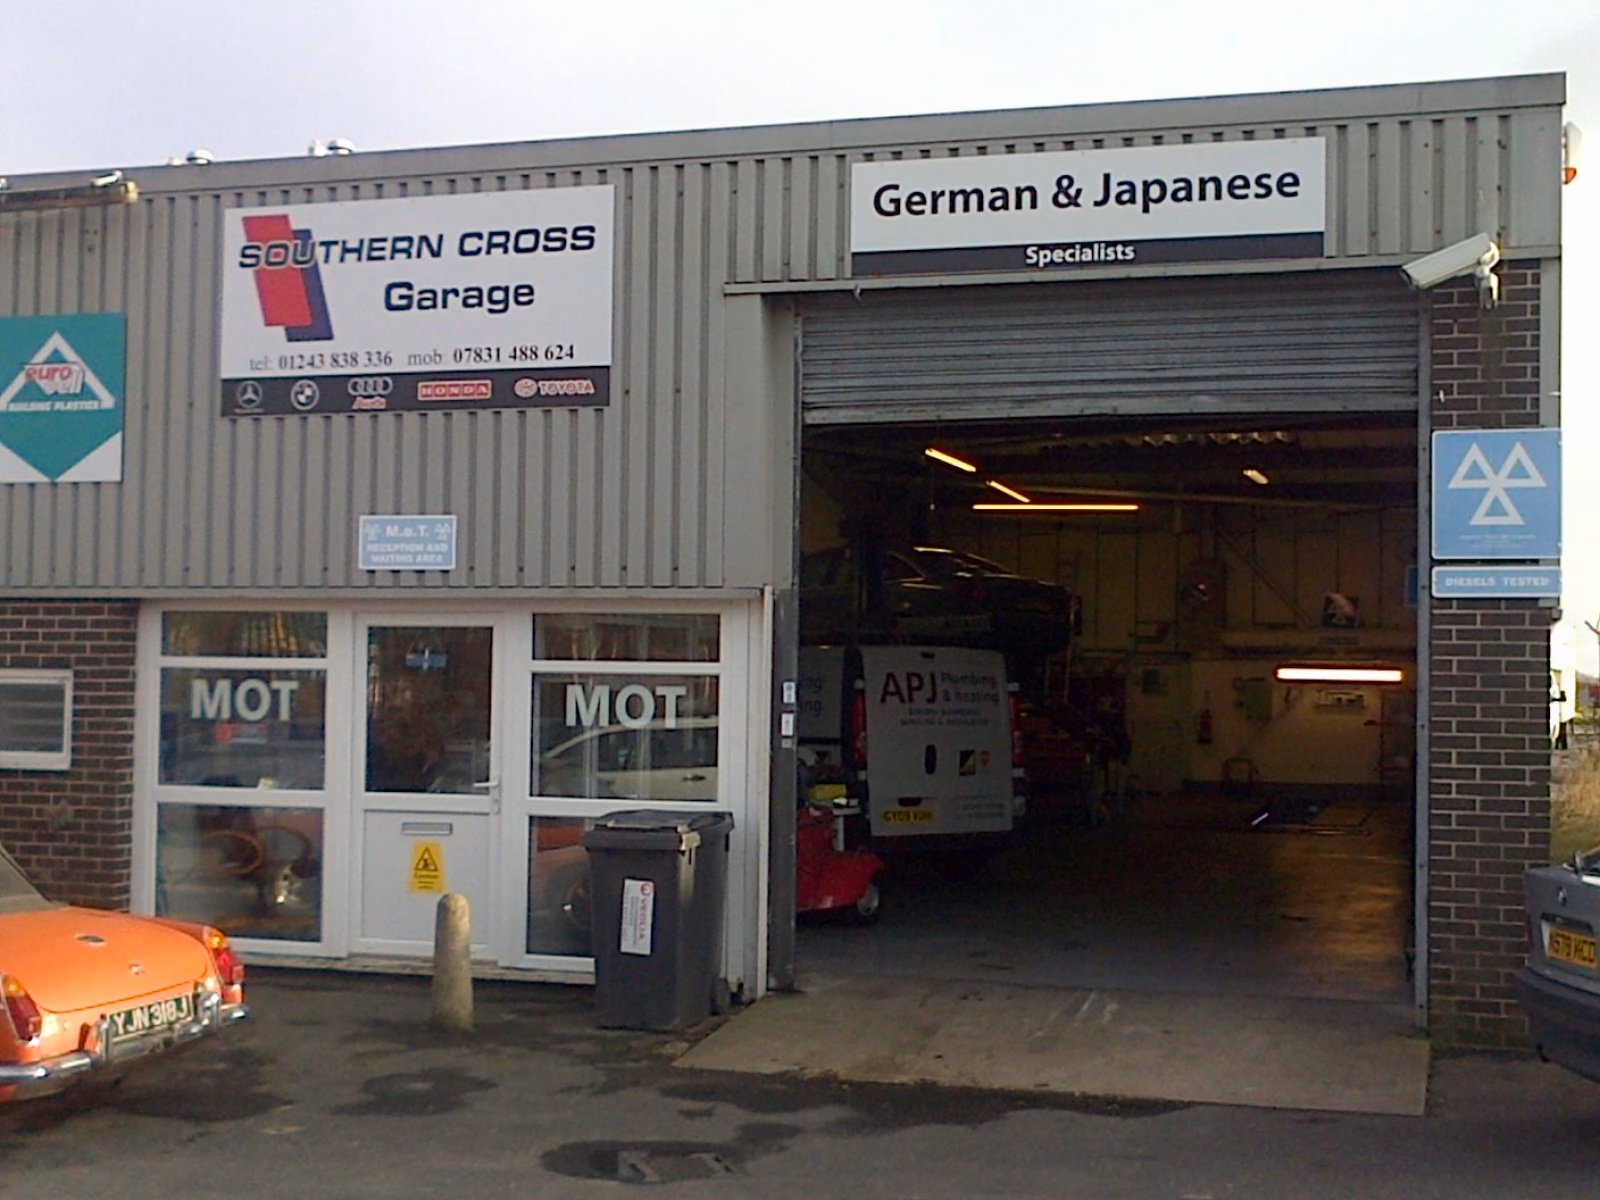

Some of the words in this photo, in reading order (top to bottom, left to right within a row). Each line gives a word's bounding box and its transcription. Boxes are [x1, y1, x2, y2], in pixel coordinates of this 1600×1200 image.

[873, 182, 1039, 218] German
[1051, 173, 1083, 208] &
[1094, 170, 1302, 214] Japanese
[238, 232, 443, 268] SOUTHERN
[457, 225, 596, 257] CROSS
[1025, 242, 1136, 268] Specialists
[383, 281, 535, 314] Garage
[249, 357, 274, 371] tel:
[278, 353, 325, 370] 01243
[329, 352, 359, 368] 838
[363, 350, 393, 366] 336
[453, 347, 501, 364] 07831
[508, 345, 539, 362] 488
[544, 344, 575, 361] 624
[24, 366, 73, 381] euro
[420, 382, 488, 398] HONDA
[538, 379, 595, 396] TOYOTA
[415, 554, 443, 563] AREA
[426, 542, 449, 552] AND
[1444, 576, 1496, 588] DIESELS
[1502, 575, 1550, 587] TESTED
[190, 677, 300, 722] MOT
[879, 671, 938, 705] APJ
[564, 683, 688, 730] MOT
[113, 1007, 150, 1036] YJN
[150, 996, 188, 1026] 318J
